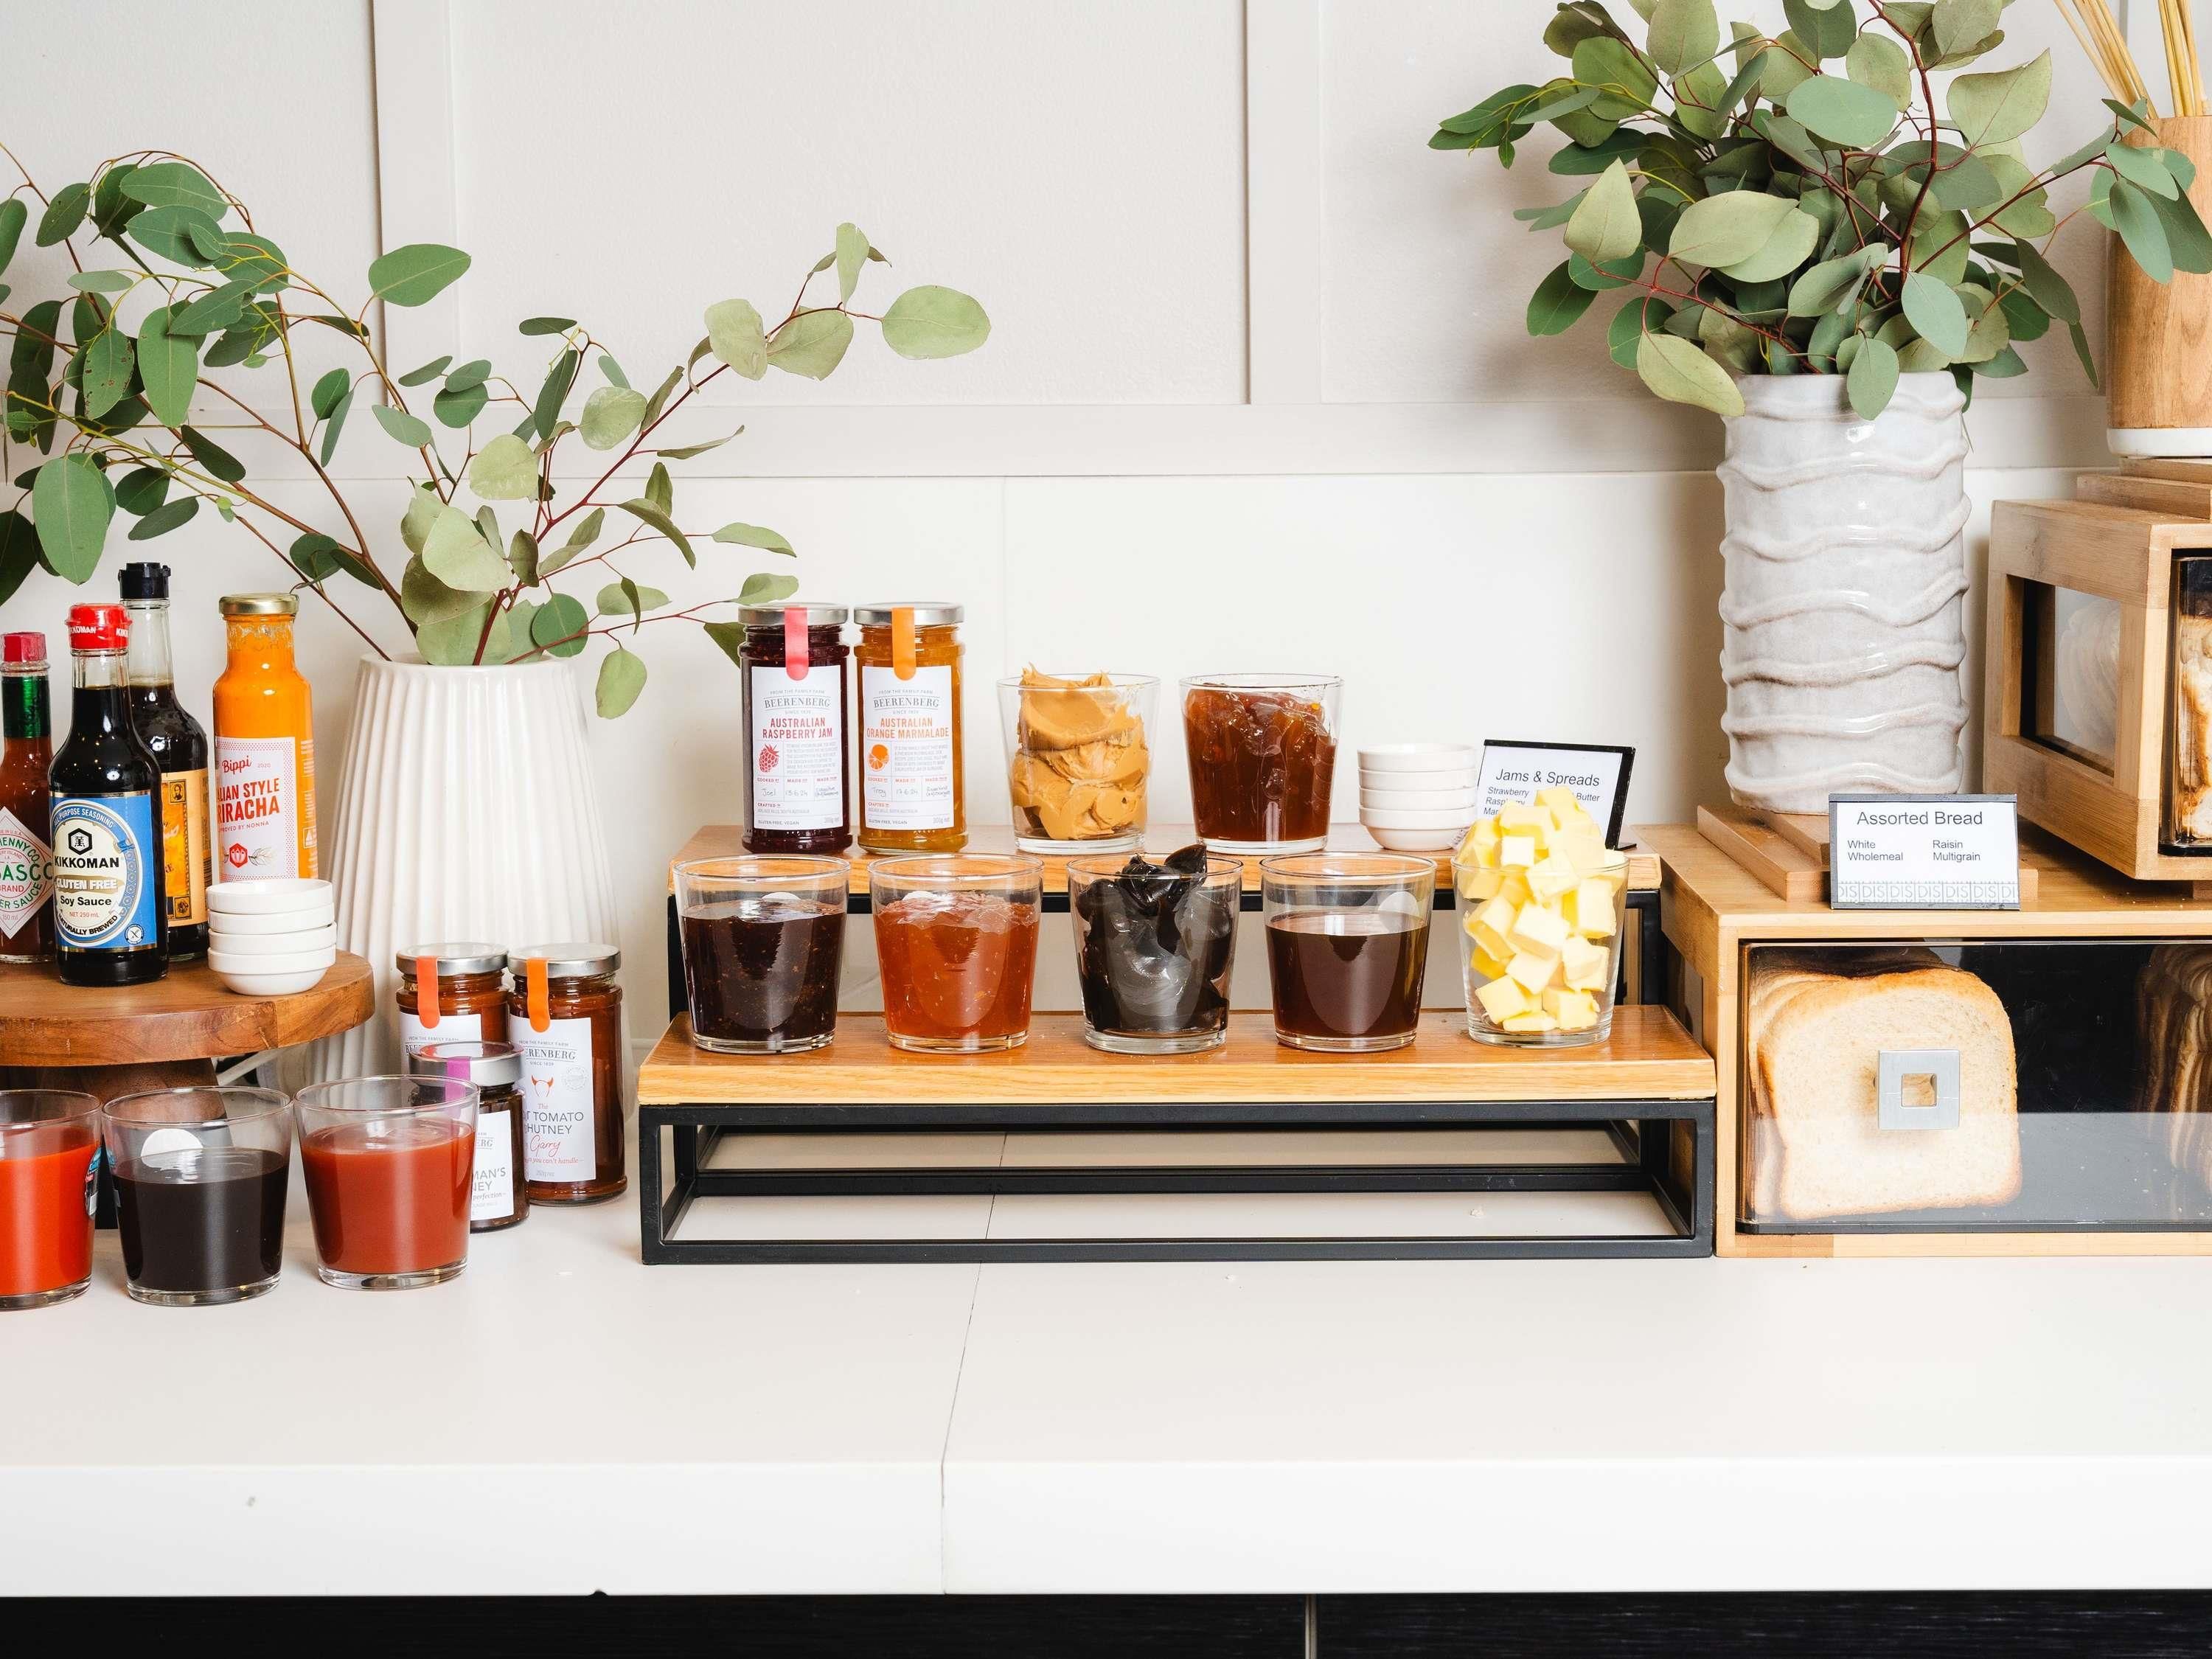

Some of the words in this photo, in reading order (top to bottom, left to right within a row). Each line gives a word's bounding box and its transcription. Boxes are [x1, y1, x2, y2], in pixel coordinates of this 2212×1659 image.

[764, 698, 830, 708] BEERENBERG
[874, 698, 939, 708] BEERENBERG
[771, 717, 826, 728] AUSTRALIAN
[880, 717, 933, 728] AUSTRALIAN
[762, 729, 816, 739] RASPBERRY
[818, 728, 832, 737] JAM
[866, 728, 895, 739] ORANGE
[897, 727, 950, 739] MARMALADE
[222, 755, 252, 775] Bippi
[1496, 769, 1529, 782] Jams
[1533, 771, 1542, 782] &
[1547, 771, 1599, 786] Spreads
[243, 778, 279, 798] STYLE
[1487, 787, 1529, 798] Strawberry
[1576, 793, 1600, 801] Butter
[1486, 797, 1525, 807] Raspy
[1484, 807, 1498, 815] Mar
[81, 808, 114, 828] SEASONING
[1857, 811, 1928, 825] Assorted
[1935, 811, 1983, 825] Bread
[246, 820, 270, 830] NONNA
[1847, 840, 1876, 849] White
[1933, 840, 1963, 849] Raisin
[55, 855, 119, 869] KIKKOMAN
[1848, 852, 1903, 861] Wholemeal
[1933, 852, 1980, 863] Multigrain
[0, 862, 52, 881] ASCO
[56, 877, 87, 889] GLUTEN
[89, 879, 118, 889] FREE
[13, 883, 43, 908] SAUCE
[1863, 886, 1885, 897] DIS
[1891, 886, 1913, 897] DIS
[1919, 886, 1941, 897] DIS
[1947, 886, 1968, 897] DIS
[1975, 886, 1996, 897] DIS
[60, 896, 74, 906] Soy
[77, 897, 112, 905] Sauce
[58, 914, 88, 935] NATURALLY
[89, 915, 118, 934] BREWED
[533, 1111, 584, 1121] TOMATO
[530, 1135, 560, 1158] Garry
[473, 1192, 502, 1201] perfection
